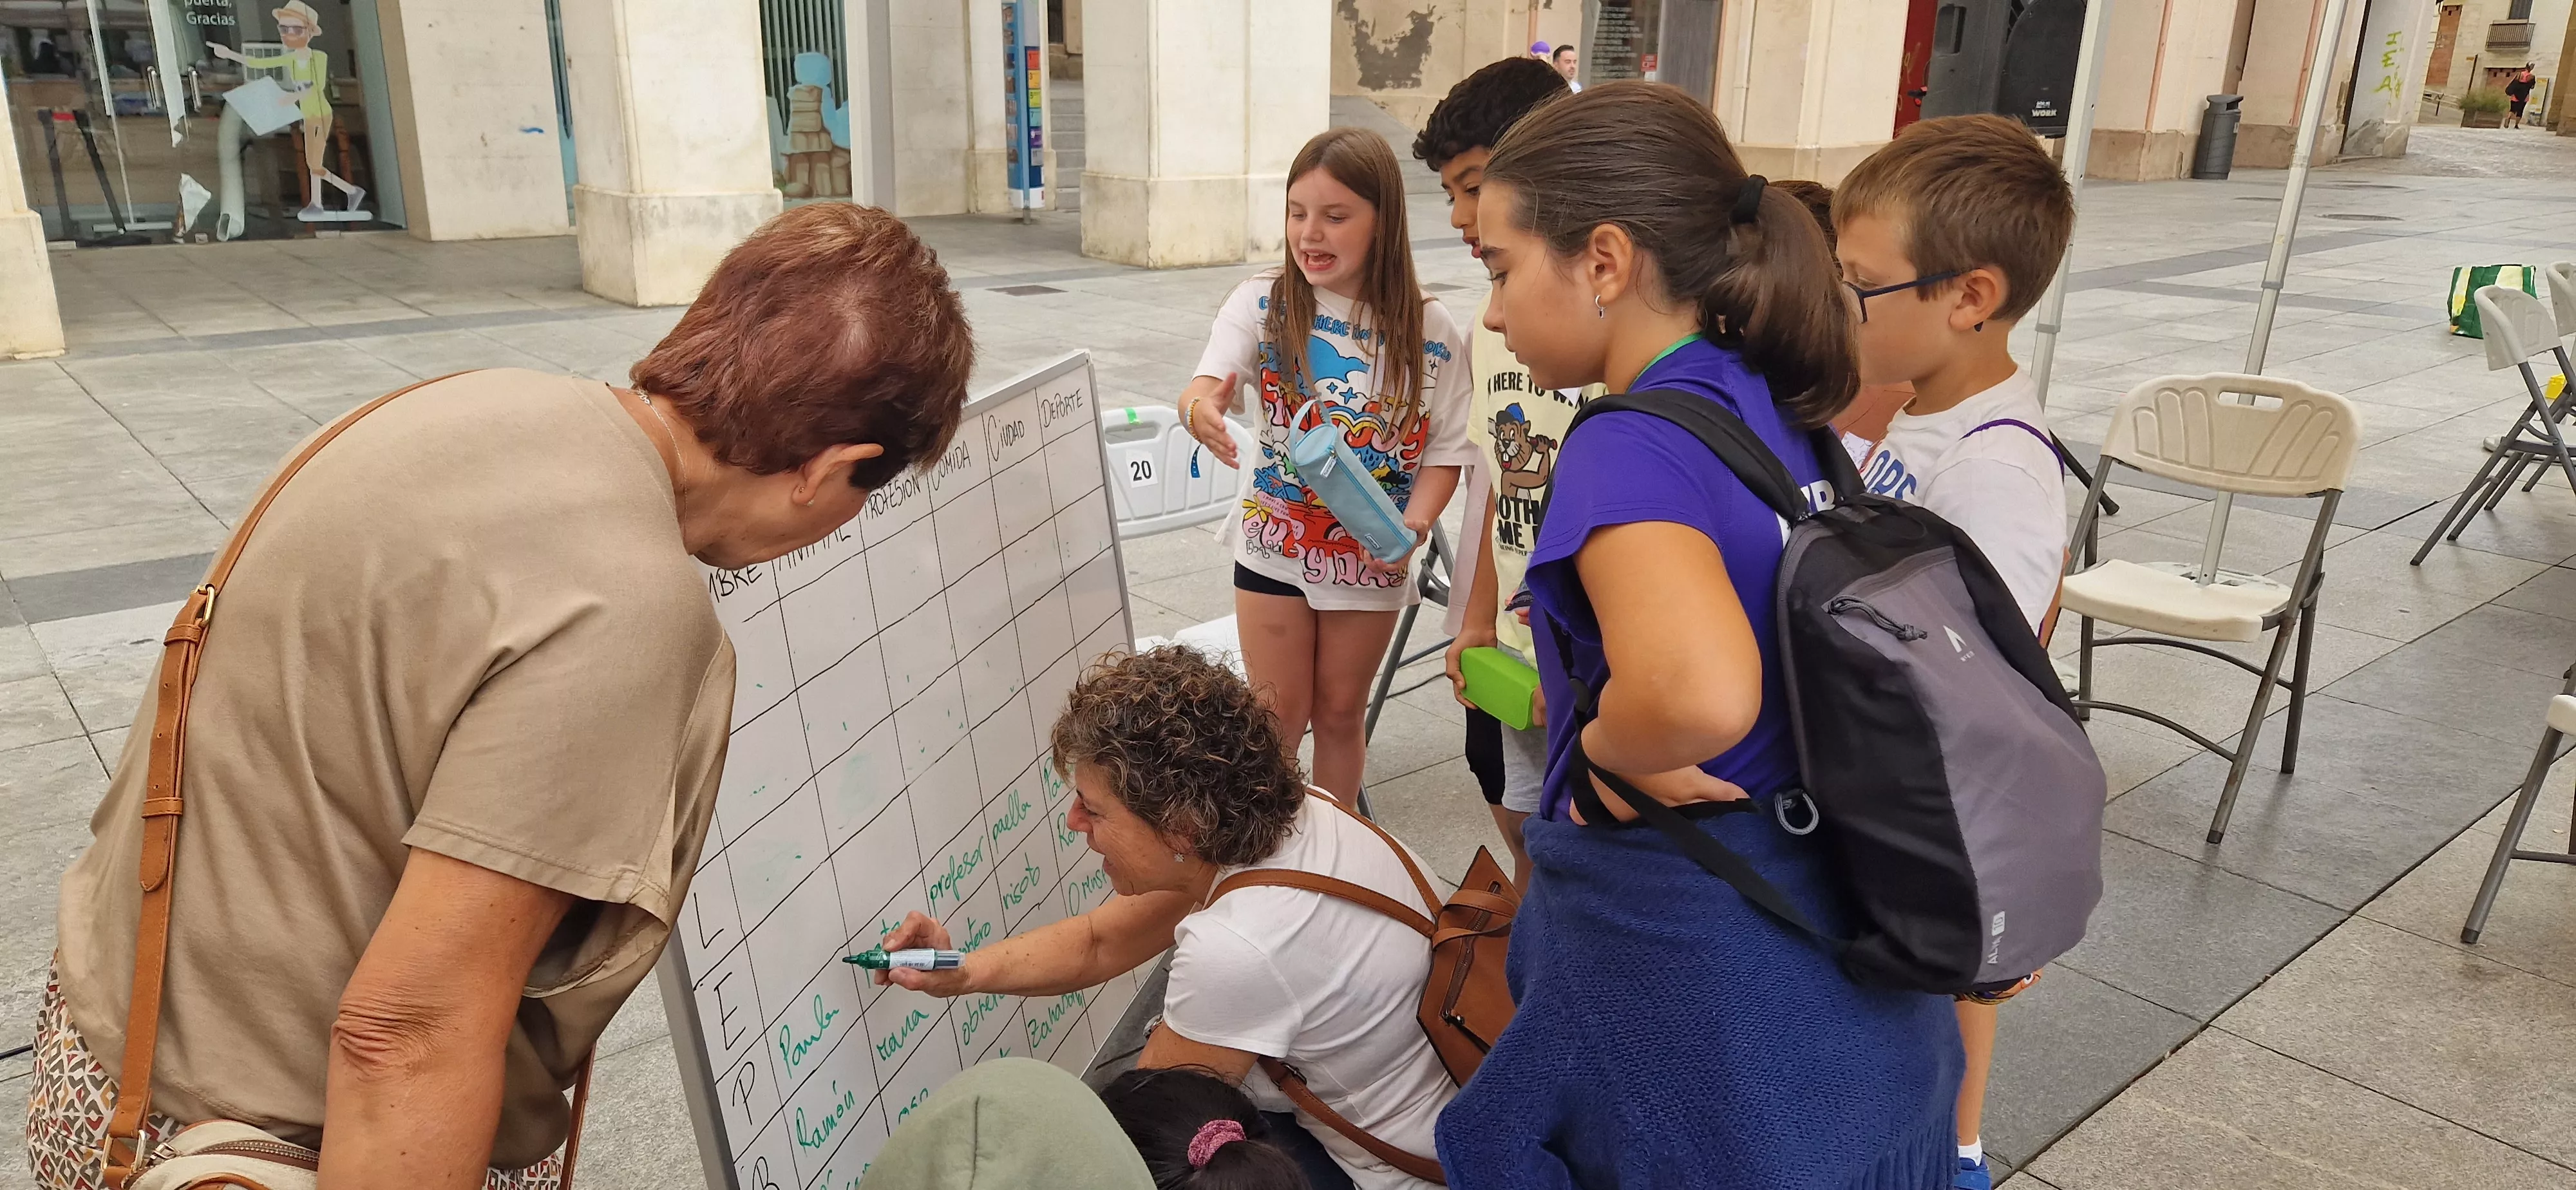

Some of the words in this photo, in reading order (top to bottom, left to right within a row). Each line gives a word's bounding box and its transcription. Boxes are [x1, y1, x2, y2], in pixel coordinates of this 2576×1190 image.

[186, 11, 236, 26] Gracias
[2031, 109, 2058, 117] WORK
[1493, 371, 1524, 394] HERE
[930, 440, 971, 491] COMIDA
[1130, 460, 1153, 482] 20
[992, 788, 1032, 855] paella
[929, 835, 983, 920] profesor
[1003, 851, 1041, 910] risoto
[694, 892, 724, 950] L
[714, 972, 746, 1050] E
[779, 994, 840, 1079] Paula
[732, 1061, 755, 1126] P
[795, 1079, 856, 1157] Ramón
